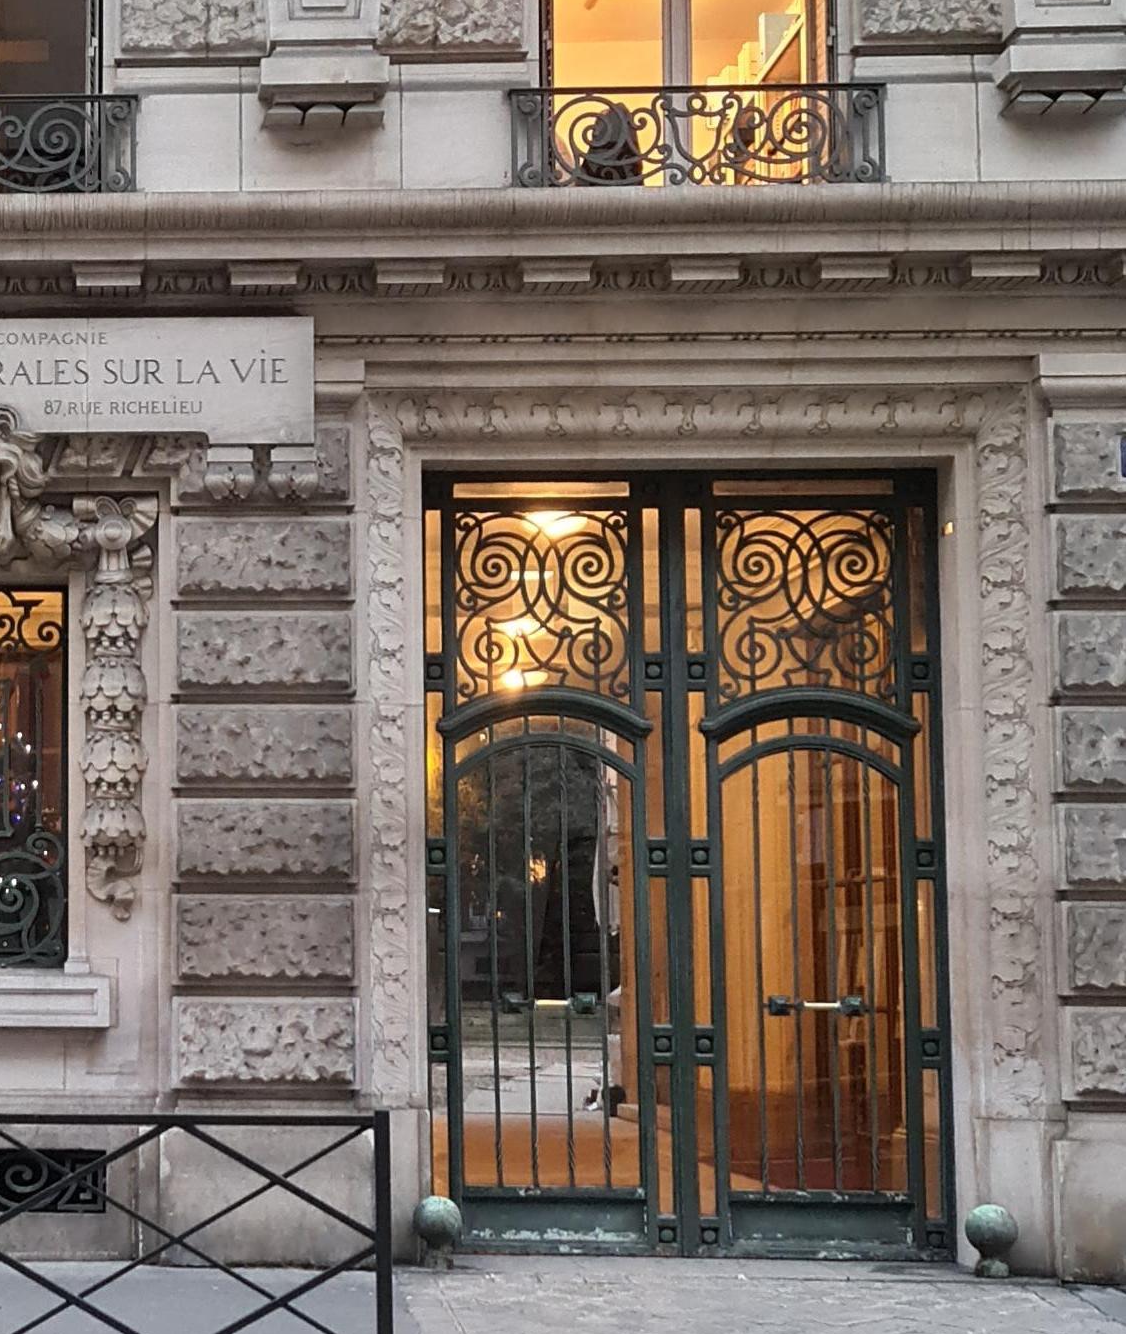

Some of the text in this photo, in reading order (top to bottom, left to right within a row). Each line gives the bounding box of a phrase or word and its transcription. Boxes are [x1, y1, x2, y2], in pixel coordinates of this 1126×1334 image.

[103, 359, 164, 385] SUR
[176, 359, 221, 384] LA
[230, 349, 290, 383] VIE
[110, 396, 203, 415] RICHELIEU
